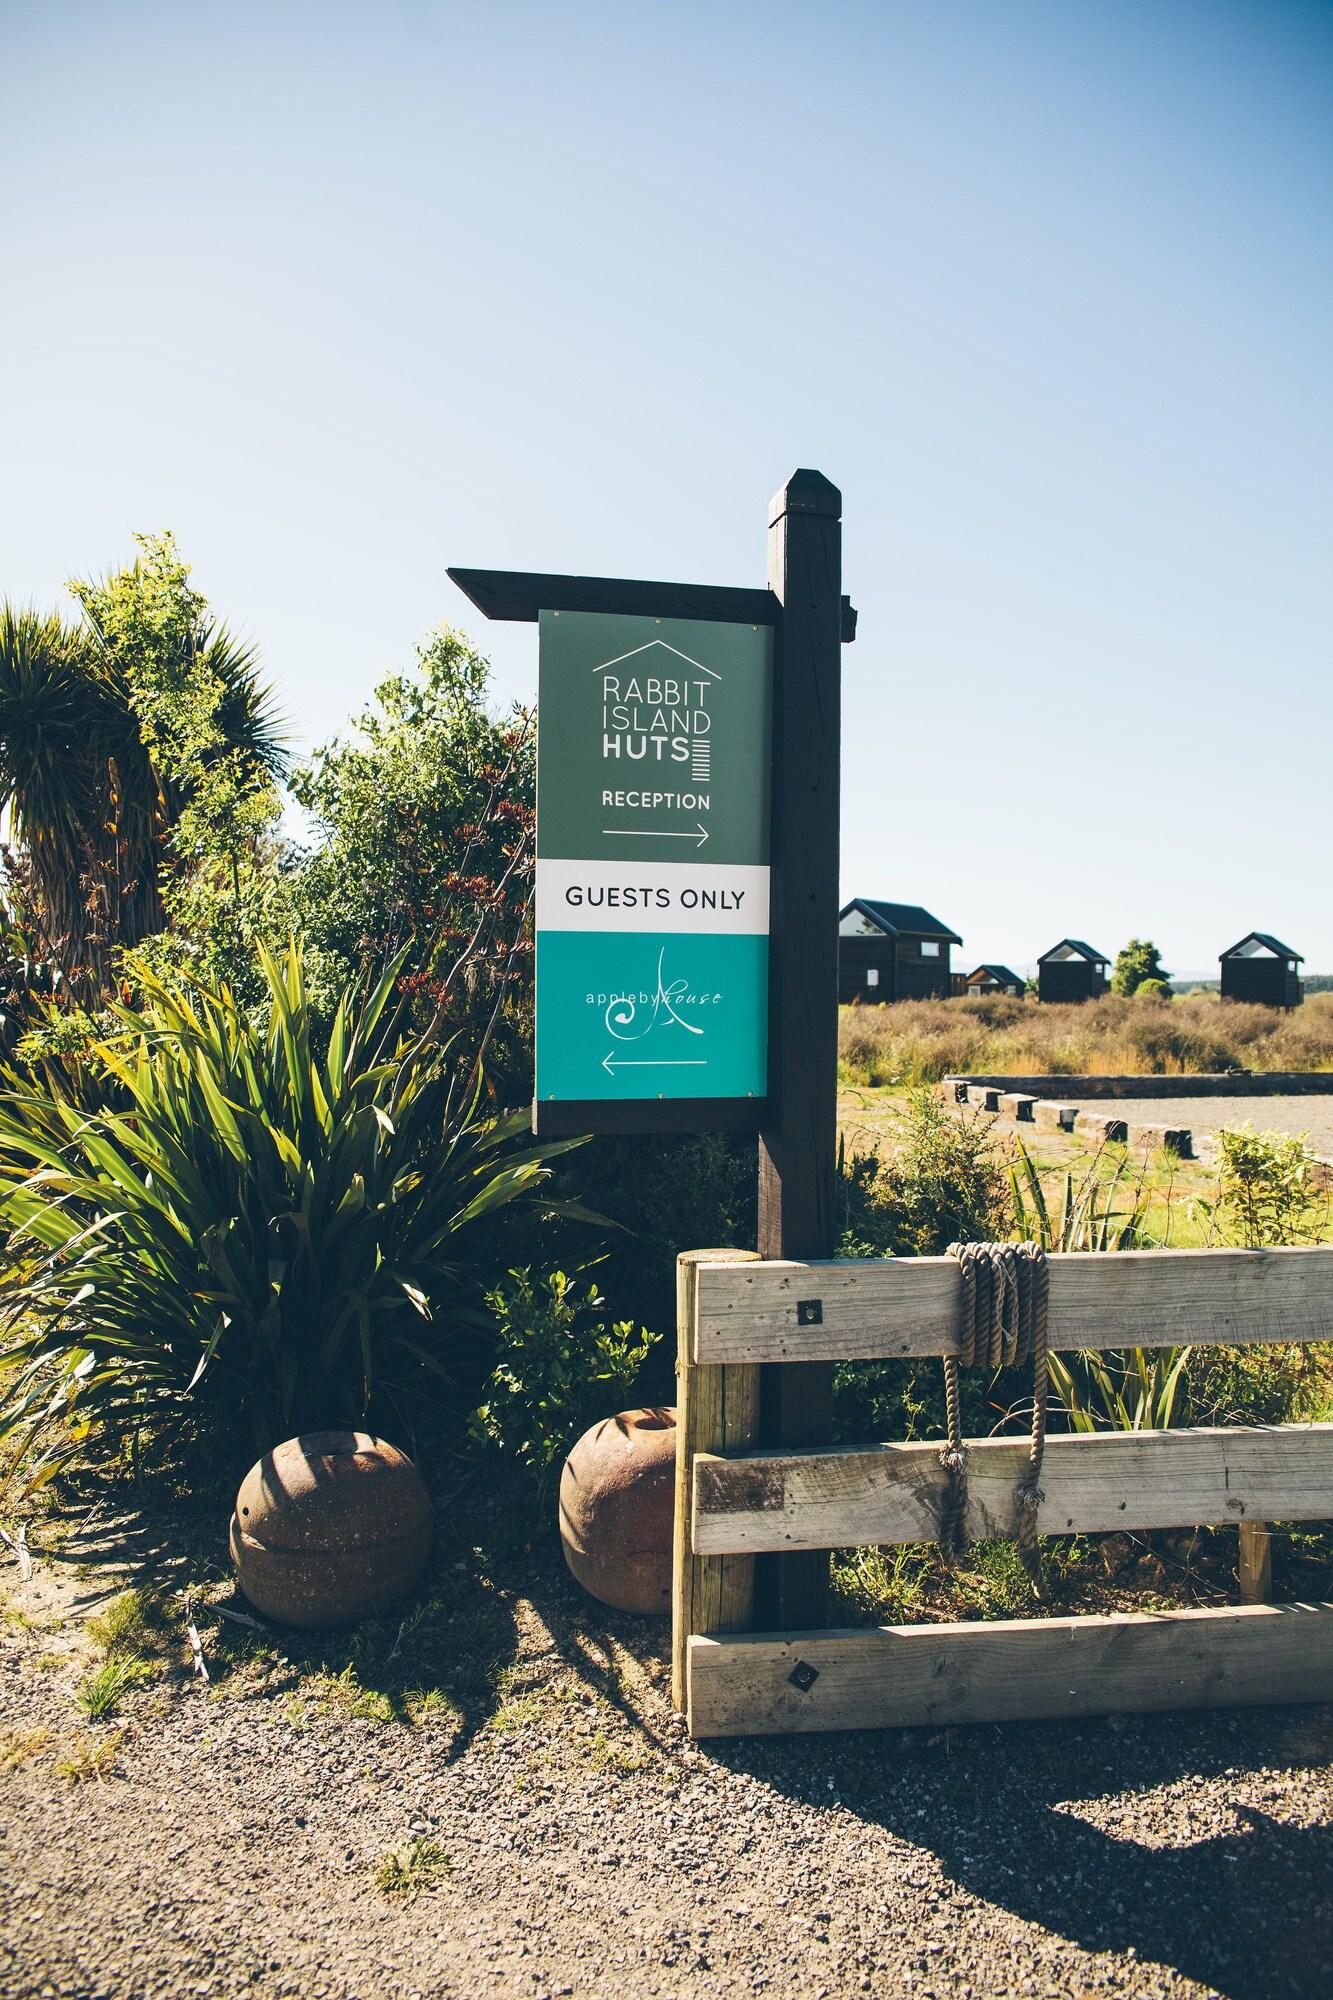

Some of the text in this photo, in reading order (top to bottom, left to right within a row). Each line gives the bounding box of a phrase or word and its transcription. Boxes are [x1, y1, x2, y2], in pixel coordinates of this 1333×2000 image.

[603, 675, 711, 707] RABBIT
[603, 705, 711, 734] ISLAND
[603, 733, 690, 761] HUTS
[602, 790, 711, 810] RECEPTION
[565, 886, 745, 910] GUESTS ONLY
